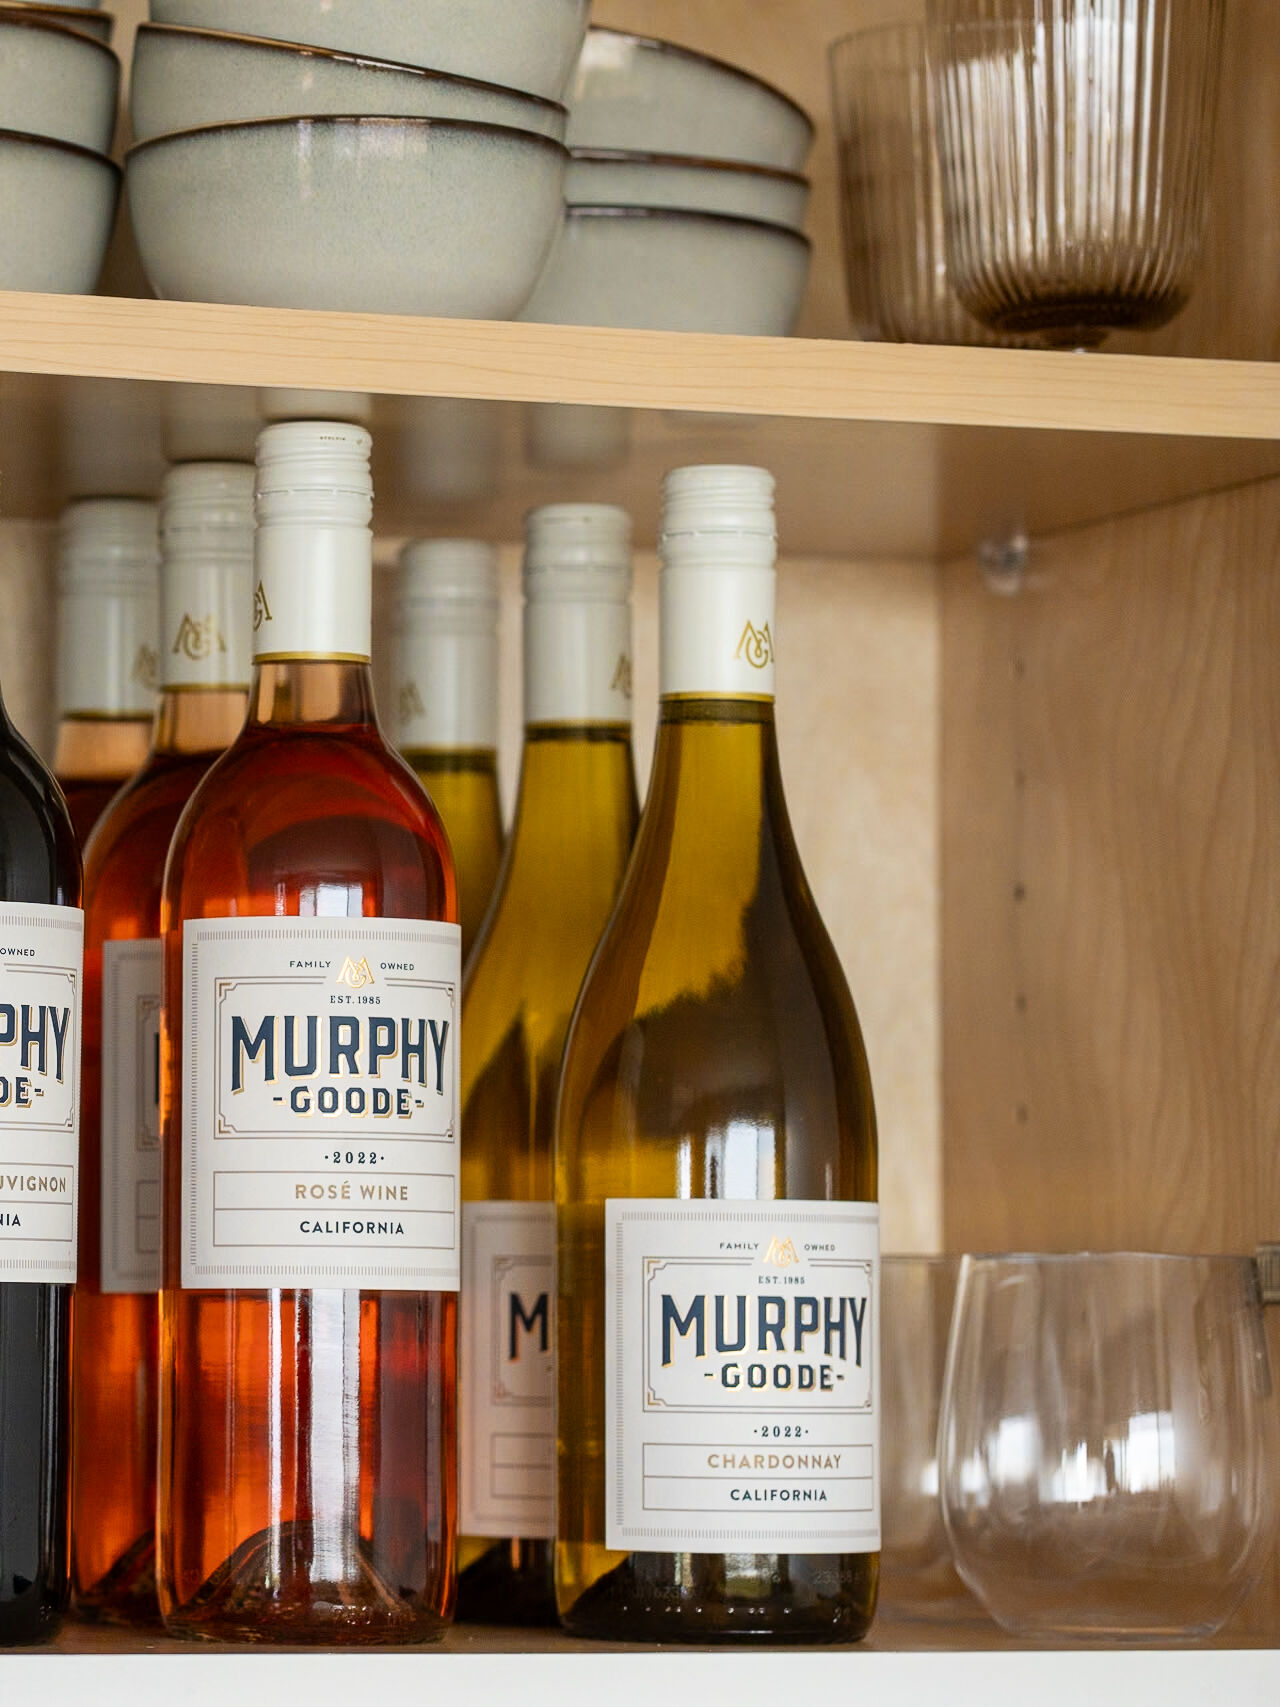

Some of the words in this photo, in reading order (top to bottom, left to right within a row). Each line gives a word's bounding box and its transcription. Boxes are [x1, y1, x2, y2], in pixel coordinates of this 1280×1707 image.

[0, 948, 35, 957] OWNED
[289, 960, 332, 968] FAMILY
[380, 962, 415, 971] OWNED
[231, 1016, 448, 1096] MURPHY
[295, 1181, 351, 1199] ROSÉ
[360, 1184, 408, 1200] WINE
[300, 1221, 404, 1234] CALIFORNIA
[719, 1242, 759, 1250] FAMILY
[661, 1294, 867, 1368] MURPHY
[708, 1454, 841, 1469] CHARDONNAY
[730, 1489, 828, 1501] CALIFORNIA
